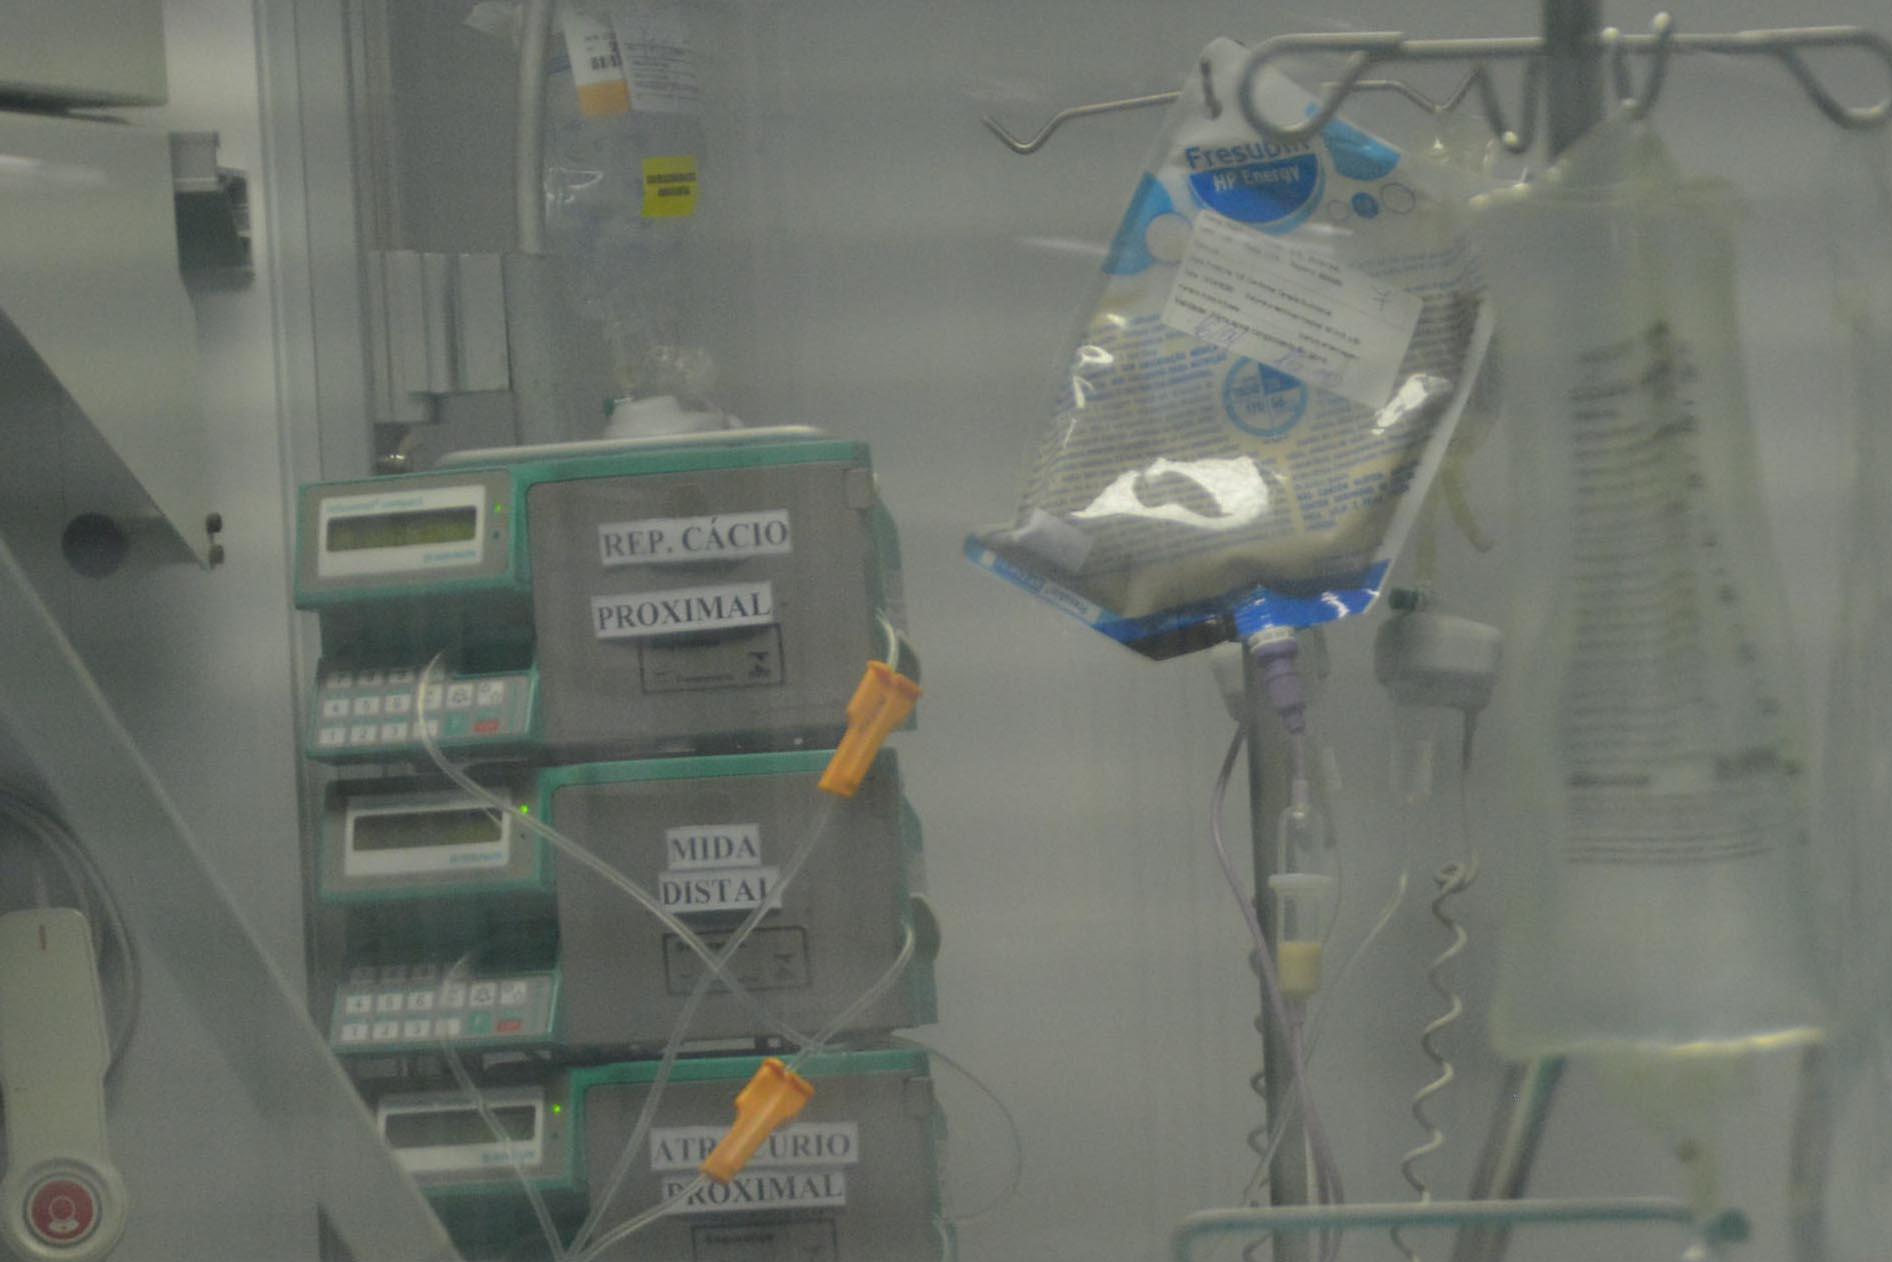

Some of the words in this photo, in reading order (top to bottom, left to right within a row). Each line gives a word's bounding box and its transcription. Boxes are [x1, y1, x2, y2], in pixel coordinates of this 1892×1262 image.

[1242, 165, 1300, 187] Energy
[602, 530, 674, 558] REP.
[681, 517, 789, 552] CÁCIO
[597, 592, 773, 631] PROXIMAL
[672, 833, 756, 861] MIDA
[655, 1132, 851, 1163] ATRURIO
